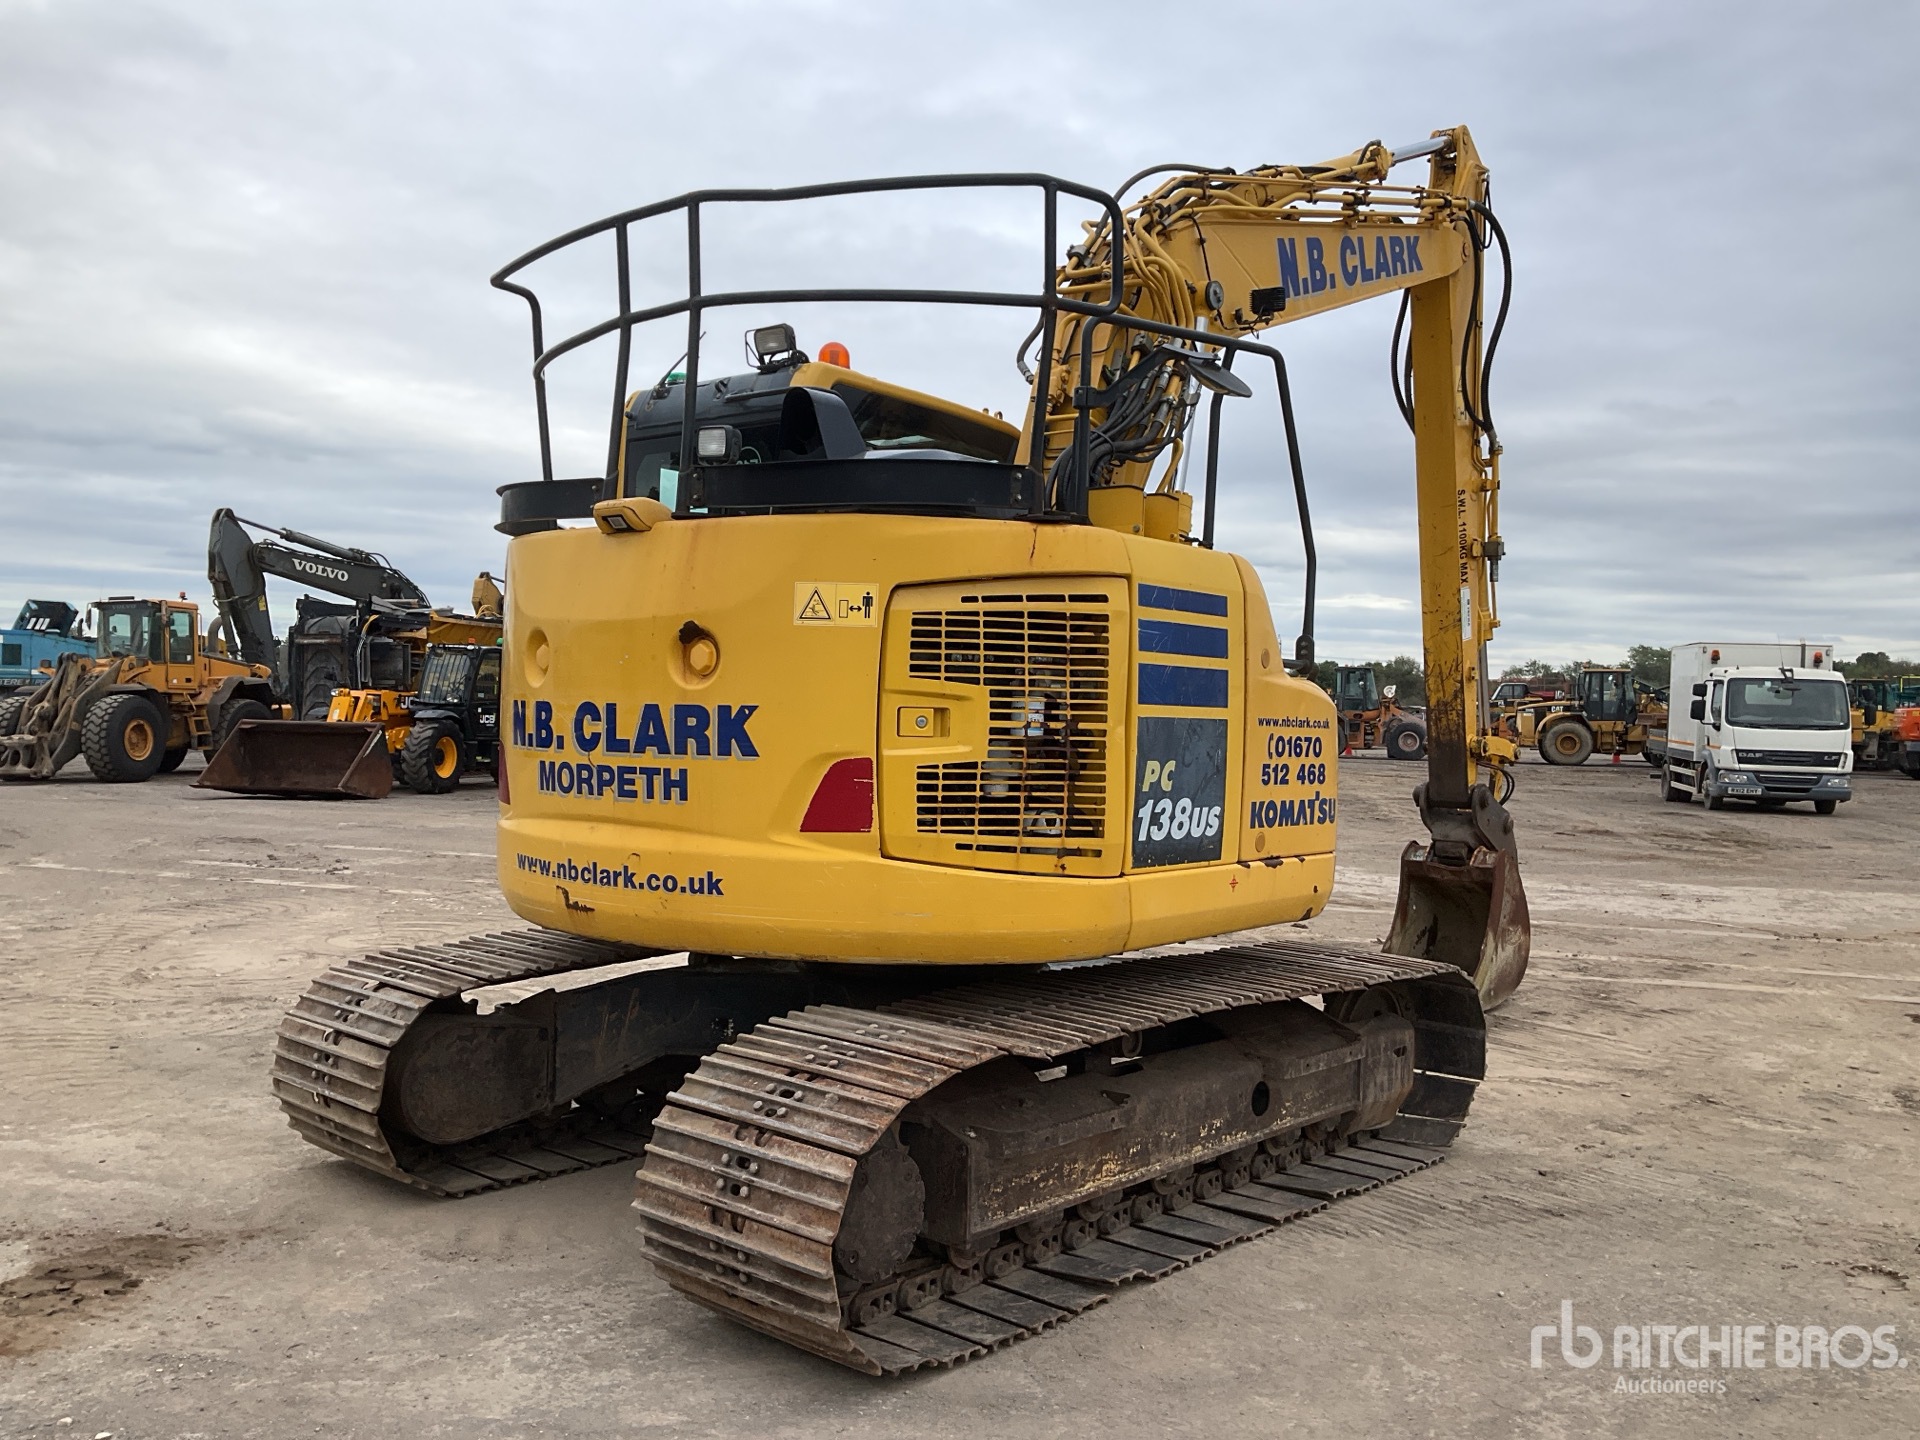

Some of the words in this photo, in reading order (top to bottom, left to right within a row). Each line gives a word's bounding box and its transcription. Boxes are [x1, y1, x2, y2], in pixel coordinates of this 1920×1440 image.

[1276, 237, 1337, 298] N.B.
[1340, 235, 1424, 286] CLARK
[1457, 489, 1466, 519] S.W.L.
[1458, 521, 1468, 560] 1100KG
[291, 558, 349, 581] VOLVO
[1459, 562, 1469, 584] MAX
[400, 696, 418, 708] JC
[479, 714, 496, 724] JCB
[512, 700, 565, 750] N.B.
[572, 701, 761, 759] CLARK
[1257, 716, 1331, 730] www.nbclark.co.uk
[1274, 735, 1323, 758] 01670
[538, 760, 689, 802] MORPETH
[1141, 760, 1177, 792] PC
[1261, 763, 1290, 786] 512
[1296, 763, 1326, 786] 468
[1249, 791, 1336, 829] KOMATSU
[516, 852, 725, 896] www.nbclark.co.uk
